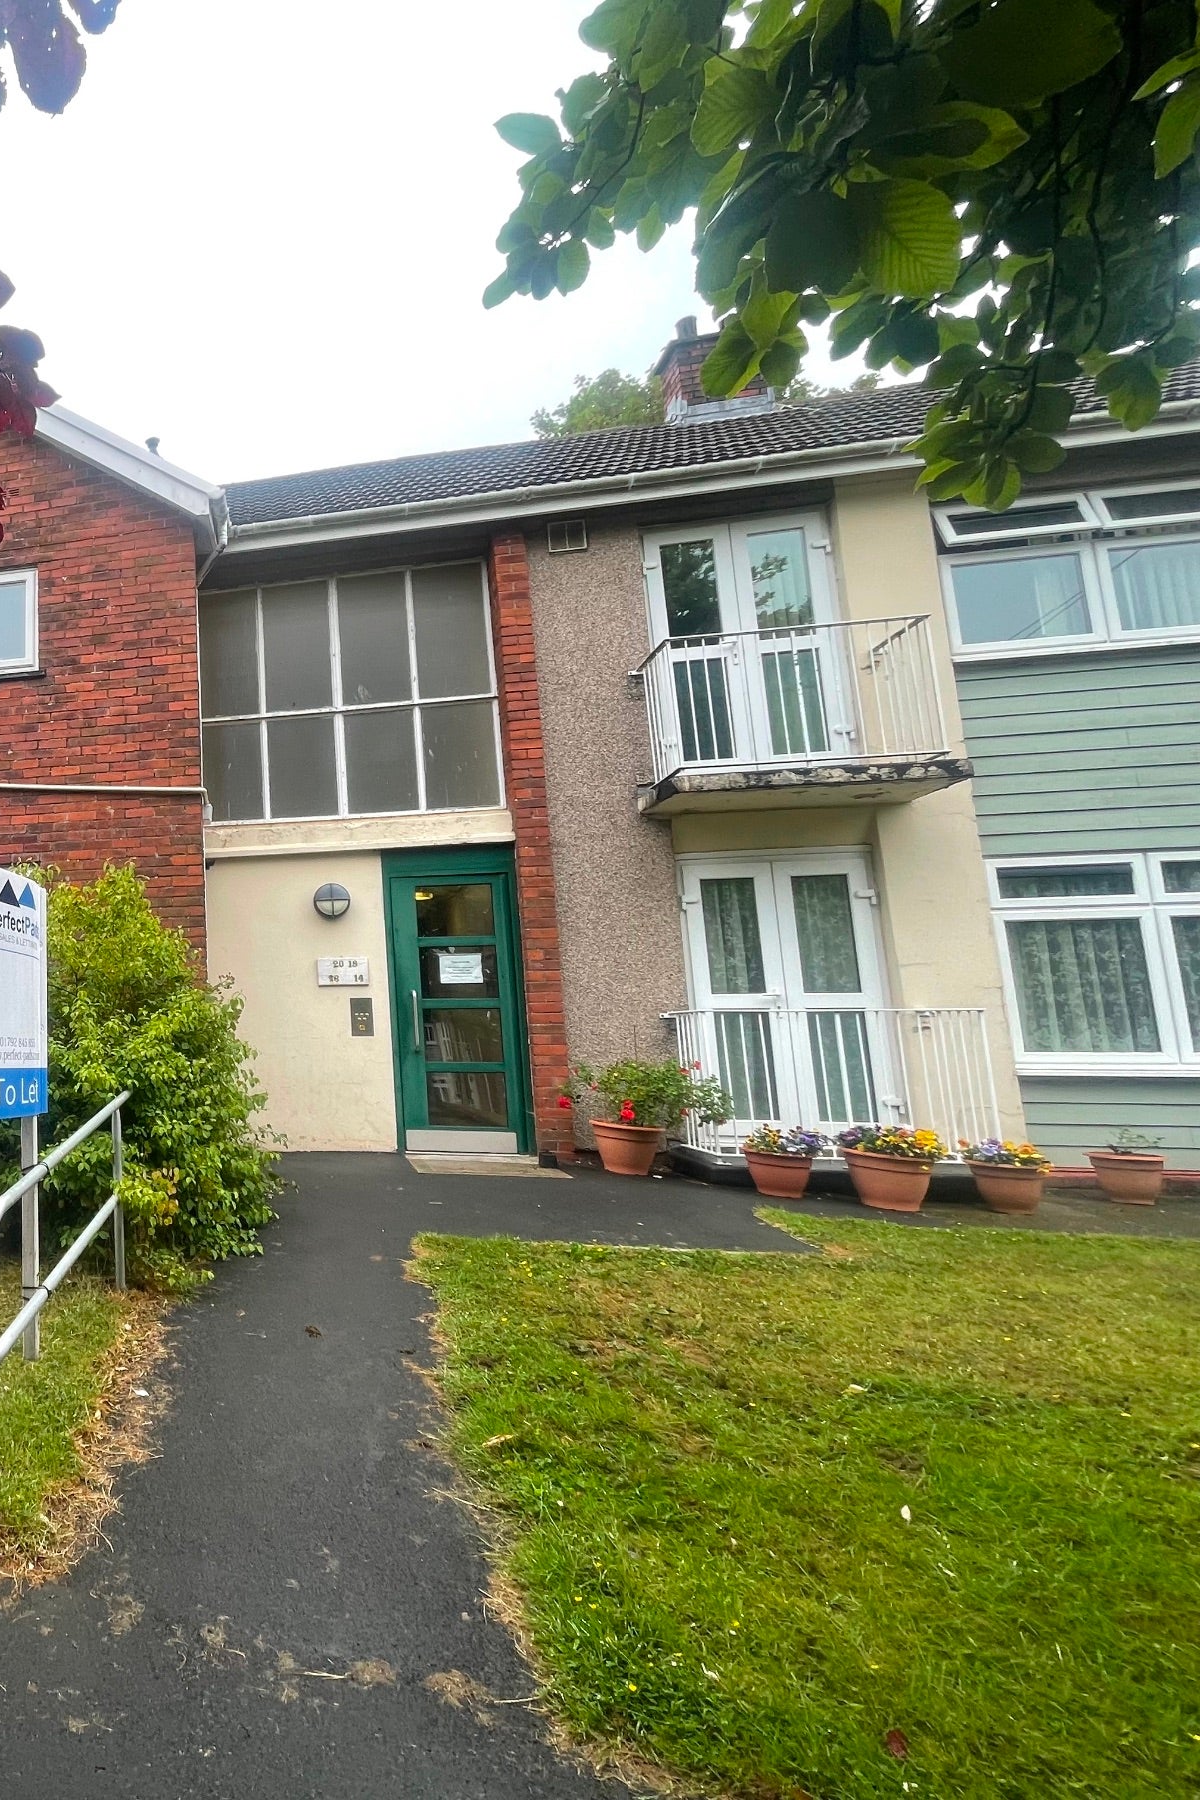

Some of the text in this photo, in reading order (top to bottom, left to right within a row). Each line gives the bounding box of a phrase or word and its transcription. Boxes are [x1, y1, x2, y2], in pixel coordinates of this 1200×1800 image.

[332, 960, 344, 968] 20
[0, 1037, 17, 1047] 01792
[21, 1077, 39, 1104] Let
